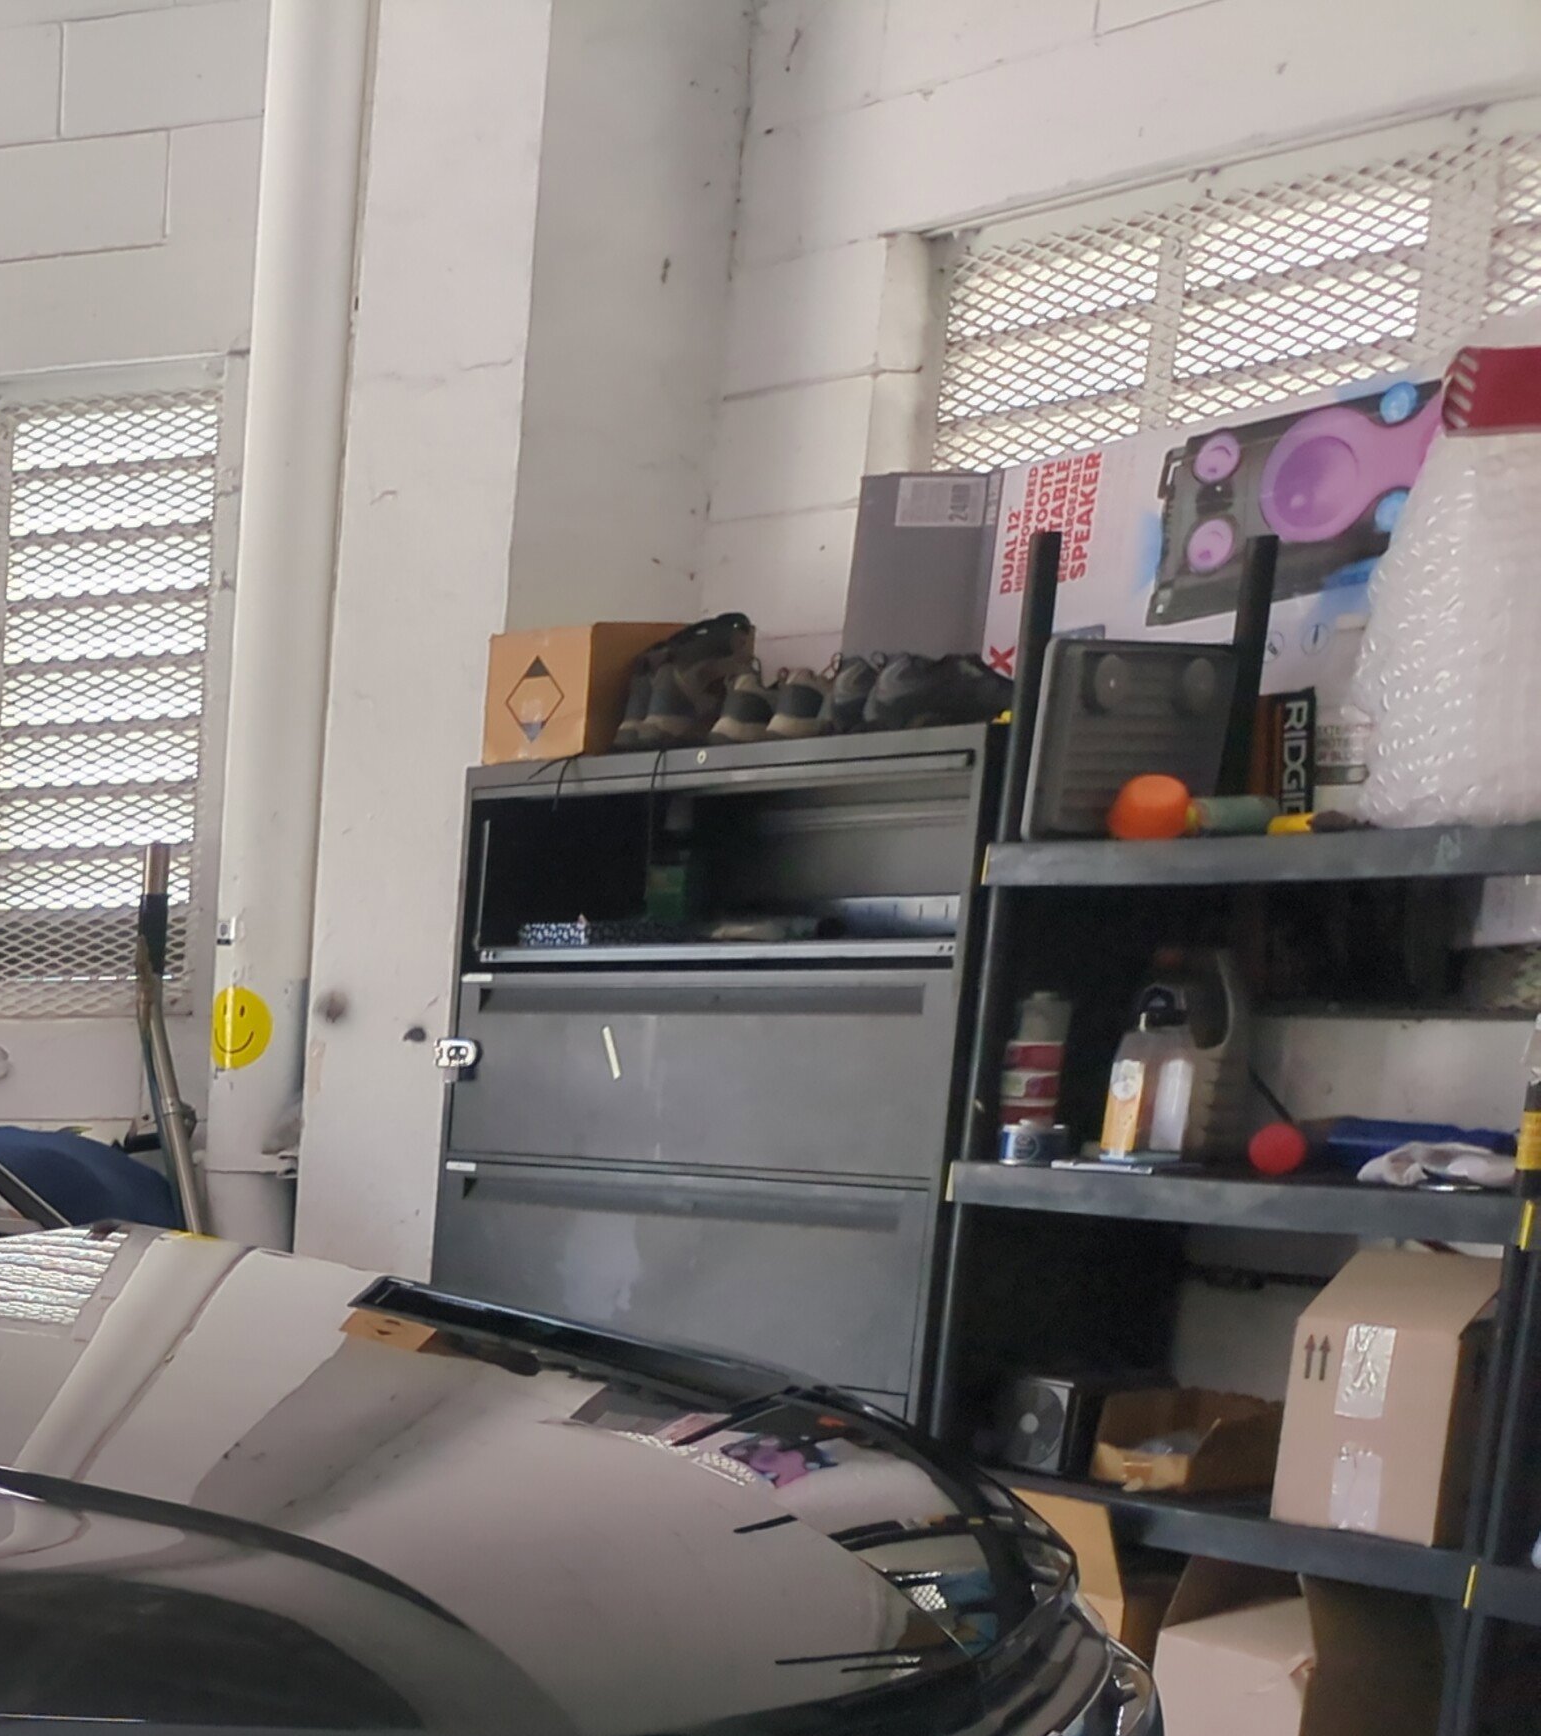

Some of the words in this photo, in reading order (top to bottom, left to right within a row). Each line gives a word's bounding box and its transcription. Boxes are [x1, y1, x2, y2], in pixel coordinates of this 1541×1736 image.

[1020, 467, 1039, 548] POWERED
[1035, 462, 1056, 534] TOOTH
[1048, 458, 1072, 532] TABLE
[1057, 458, 1083, 583] RECHARGEABLE
[1069, 451, 1103, 580] SPEAKER
[1000, 536, 1019, 594] DUAL
[1014, 549, 1028, 592] HIGH
